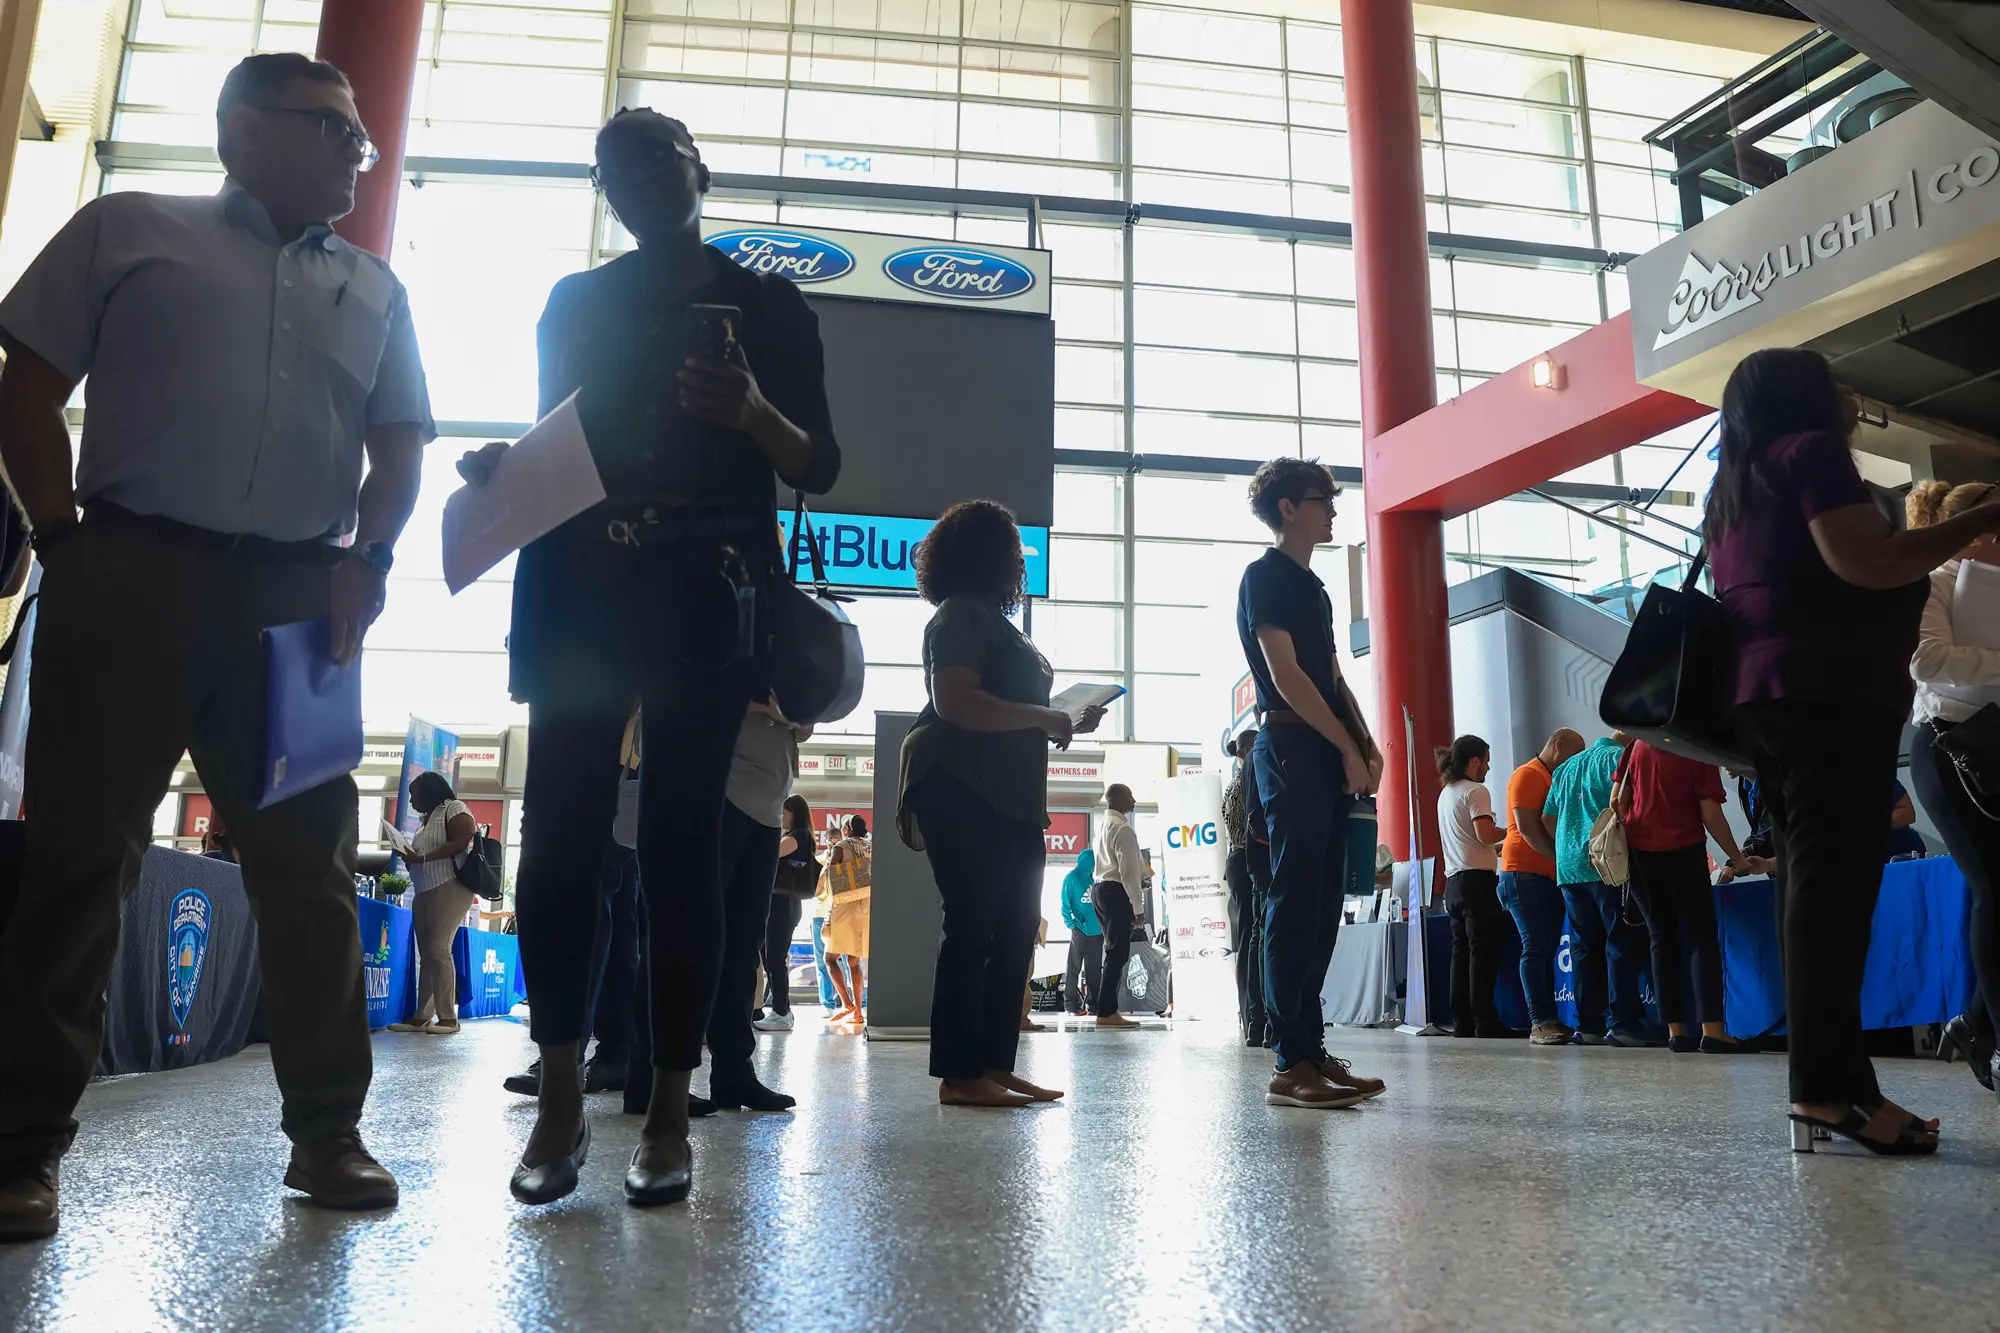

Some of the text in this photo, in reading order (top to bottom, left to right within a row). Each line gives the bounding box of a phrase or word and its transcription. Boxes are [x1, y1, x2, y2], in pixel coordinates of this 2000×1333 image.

[730, 236, 825, 277] Ford
[1660, 252, 1778, 335] Coors
[1779, 189, 1899, 279] LIGHT
[913, 253, 1006, 294] Ford
[829, 757, 843, 768] EXIT
[1047, 767, 1097, 776] PANTHERS.COM
[1167, 822, 1217, 849] CMG
[178, 896, 206, 916] POLICE
[173, 910, 207, 933] DEPARTMENT
[185, 945, 204, 1006] SUNRISE
[172, 986, 182, 1007] OF
